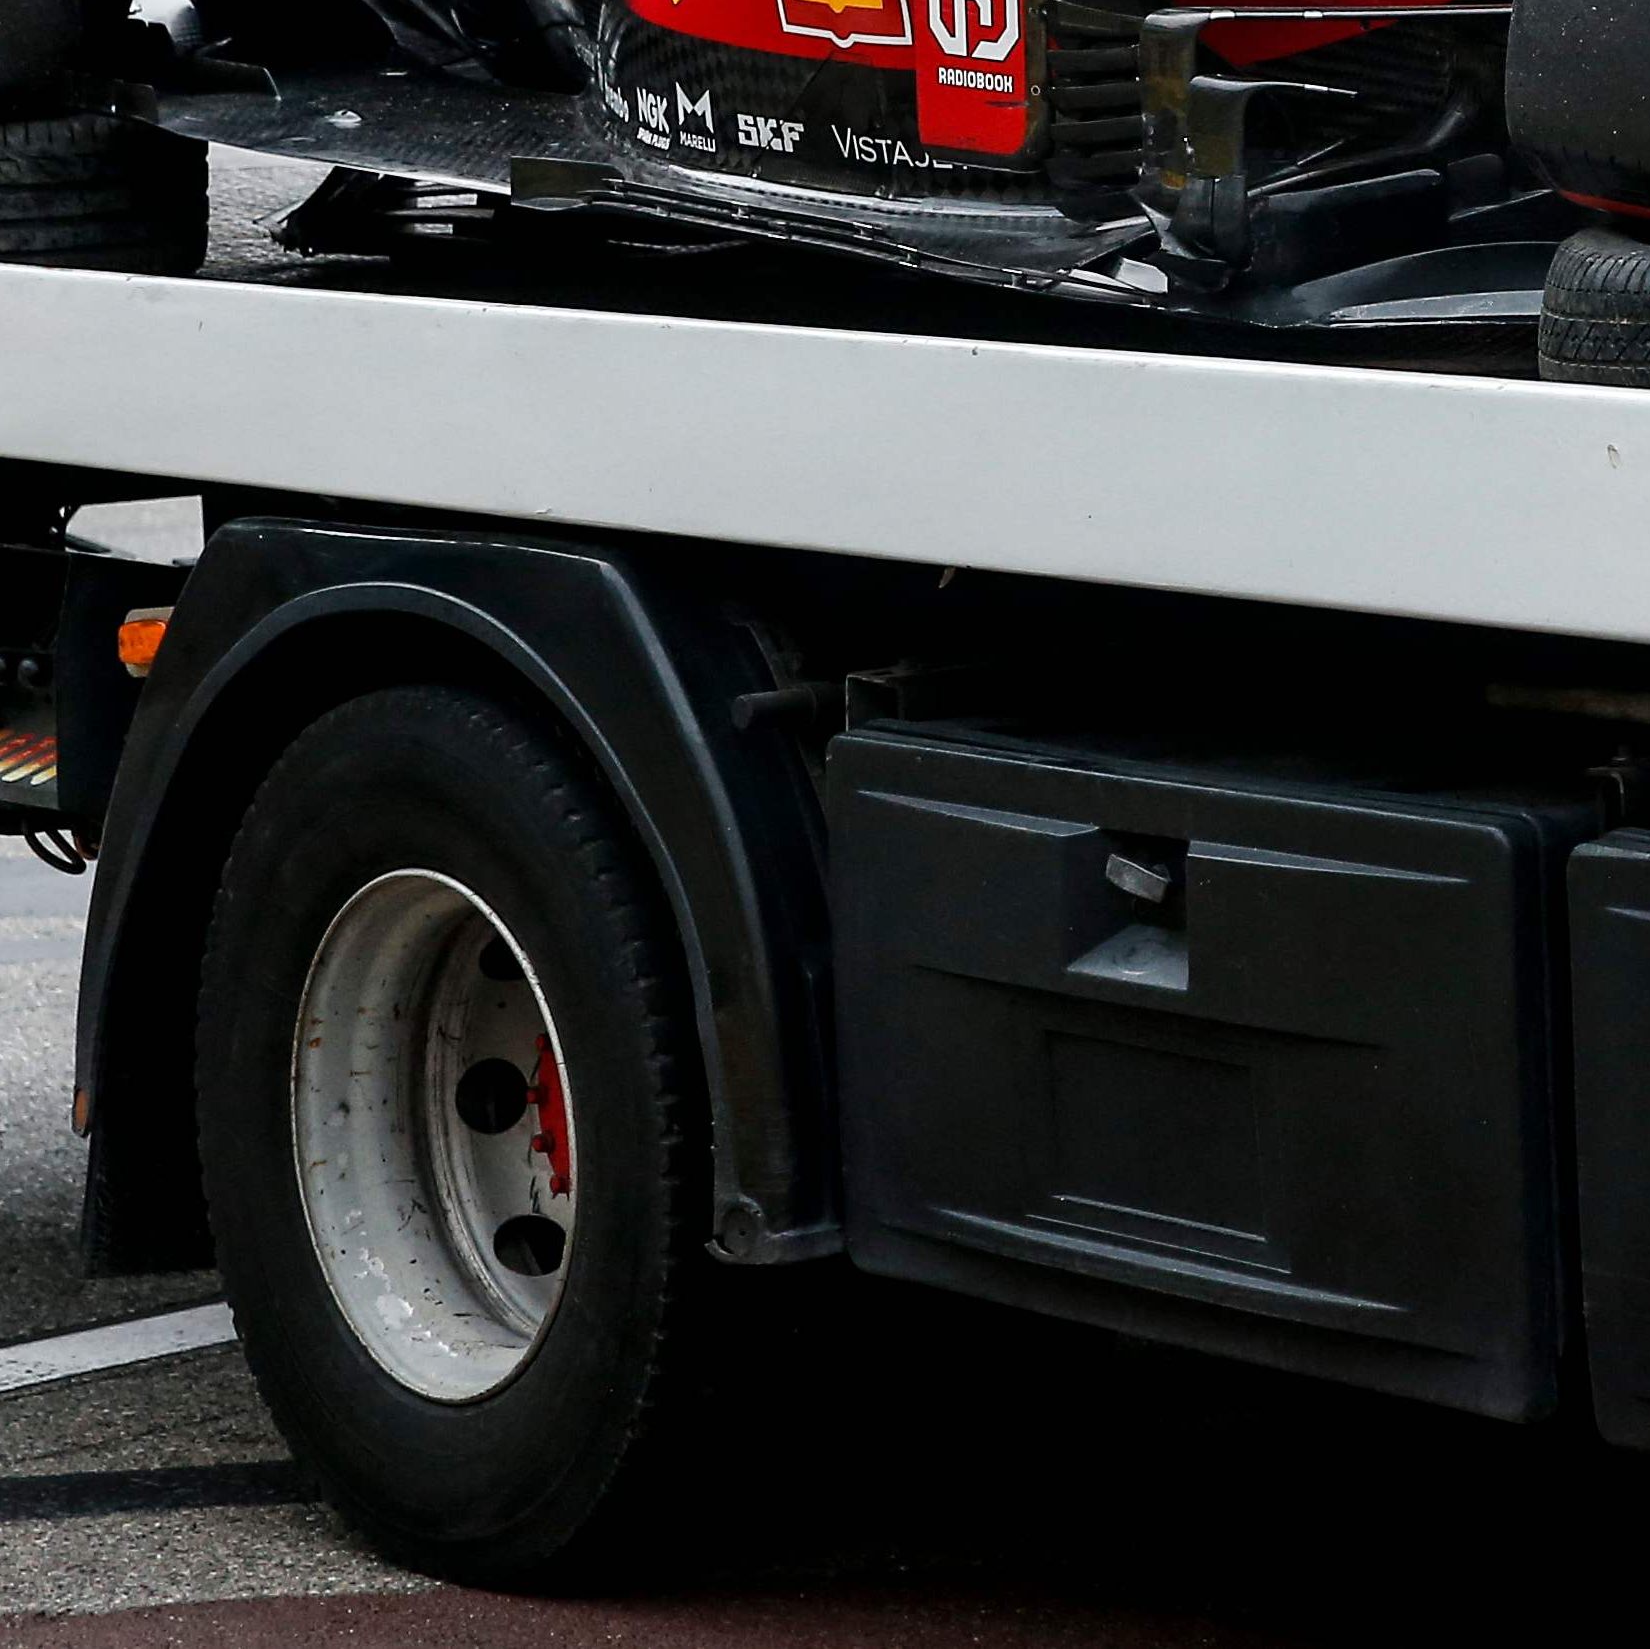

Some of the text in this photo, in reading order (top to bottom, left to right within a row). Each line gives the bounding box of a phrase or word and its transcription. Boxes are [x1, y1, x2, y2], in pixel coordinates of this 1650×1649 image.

[938, 66, 1013, 93] RADIOBOOK
[637, 86, 670, 135] NGK
[680, 130, 716, 153] MARELLI
[737, 113, 804, 153] SKF
[831, 124, 968, 170] VISTAJ
